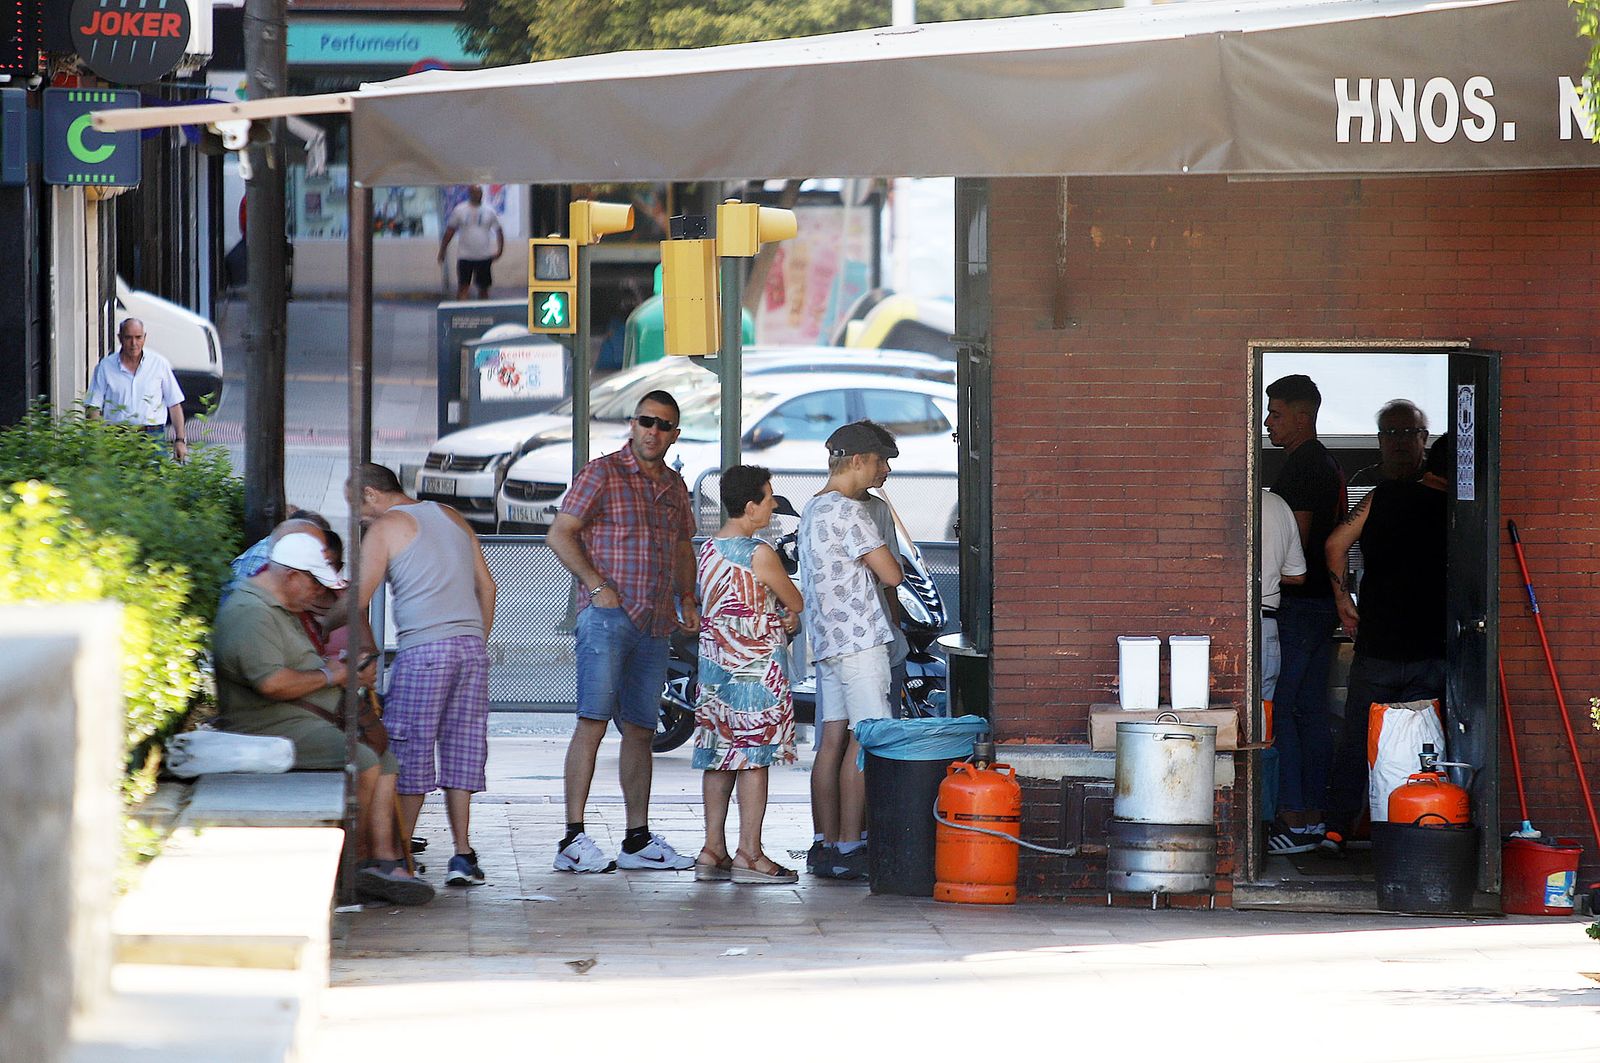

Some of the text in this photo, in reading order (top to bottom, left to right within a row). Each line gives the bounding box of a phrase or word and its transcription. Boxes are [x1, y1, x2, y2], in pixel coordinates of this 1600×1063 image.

[80, 11, 181, 37] JOKER
[320, 32, 419, 51] Perfumería
[1334, 76, 1516, 143] HNOS.
